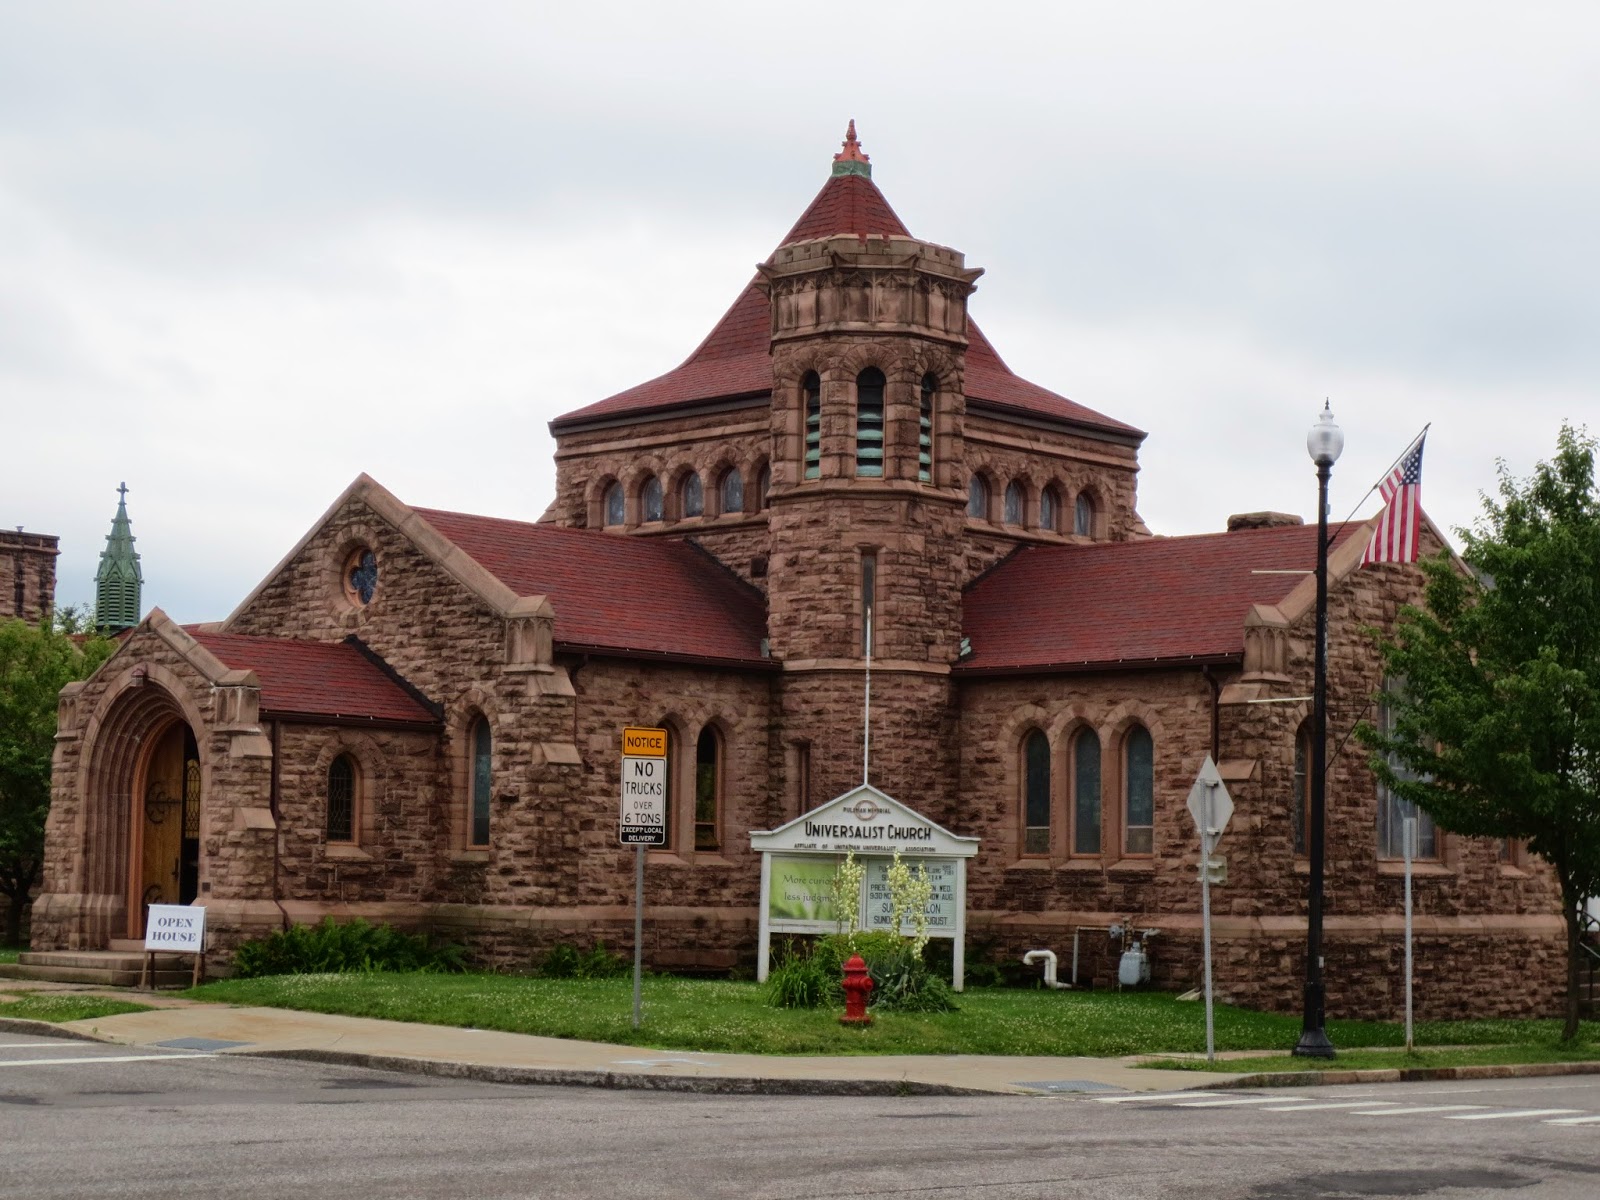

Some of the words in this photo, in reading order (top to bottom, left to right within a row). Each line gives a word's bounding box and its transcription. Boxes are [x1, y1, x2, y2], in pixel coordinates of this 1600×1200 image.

[627, 736, 662, 748] NOTICE
[634, 761, 654, 777] NO
[625, 781, 662, 796] TRUCKS
[633, 801, 653, 810] OVER
[624, 812, 631, 824] 6
[635, 813, 661, 824] TONS
[805, 821, 885, 840] UNIVERSALIST
[887, 824, 932, 841] CHURCH
[782, 874, 807, 885] More
[784, 891, 801, 901] less
[157, 917, 194, 928] OPEN
[925, 917, 948, 926] UGUST
[151, 931, 197, 943] HOUSE
